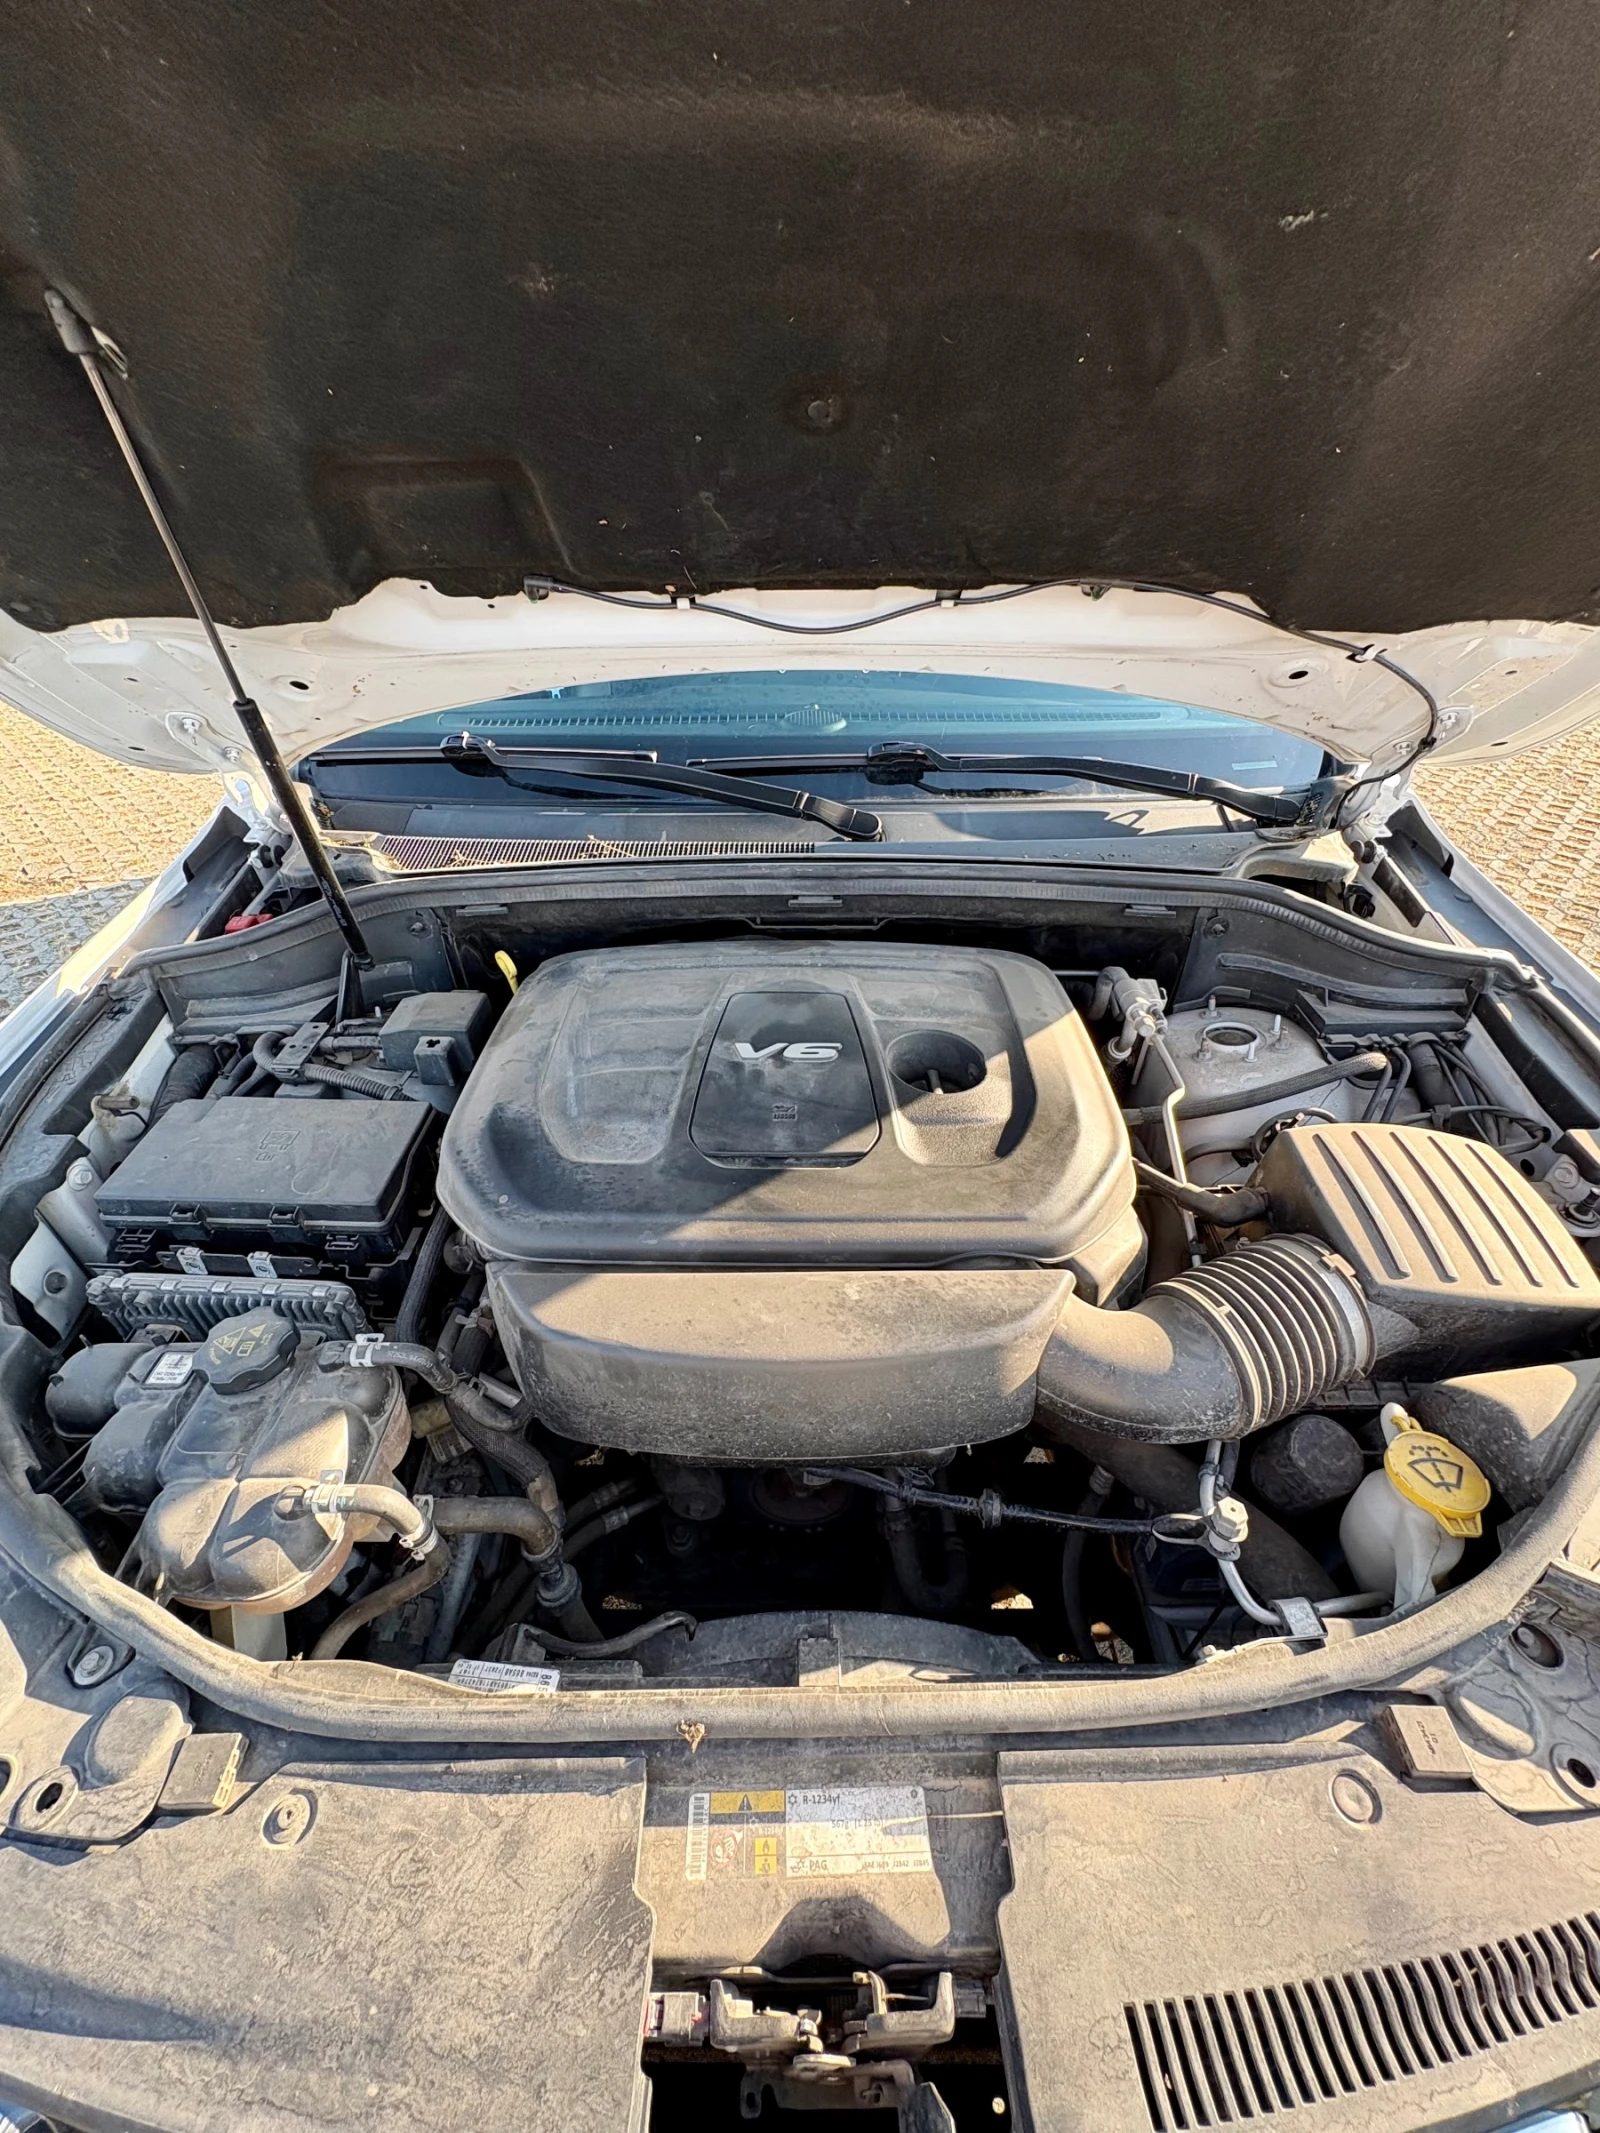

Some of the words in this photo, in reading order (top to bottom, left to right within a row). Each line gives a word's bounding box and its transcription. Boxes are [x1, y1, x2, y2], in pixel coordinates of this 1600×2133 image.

[734, 1042, 843, 1062] V6
[802, 1794, 840, 1805] R-1234yf
[809, 1860, 827, 1870] PAG
